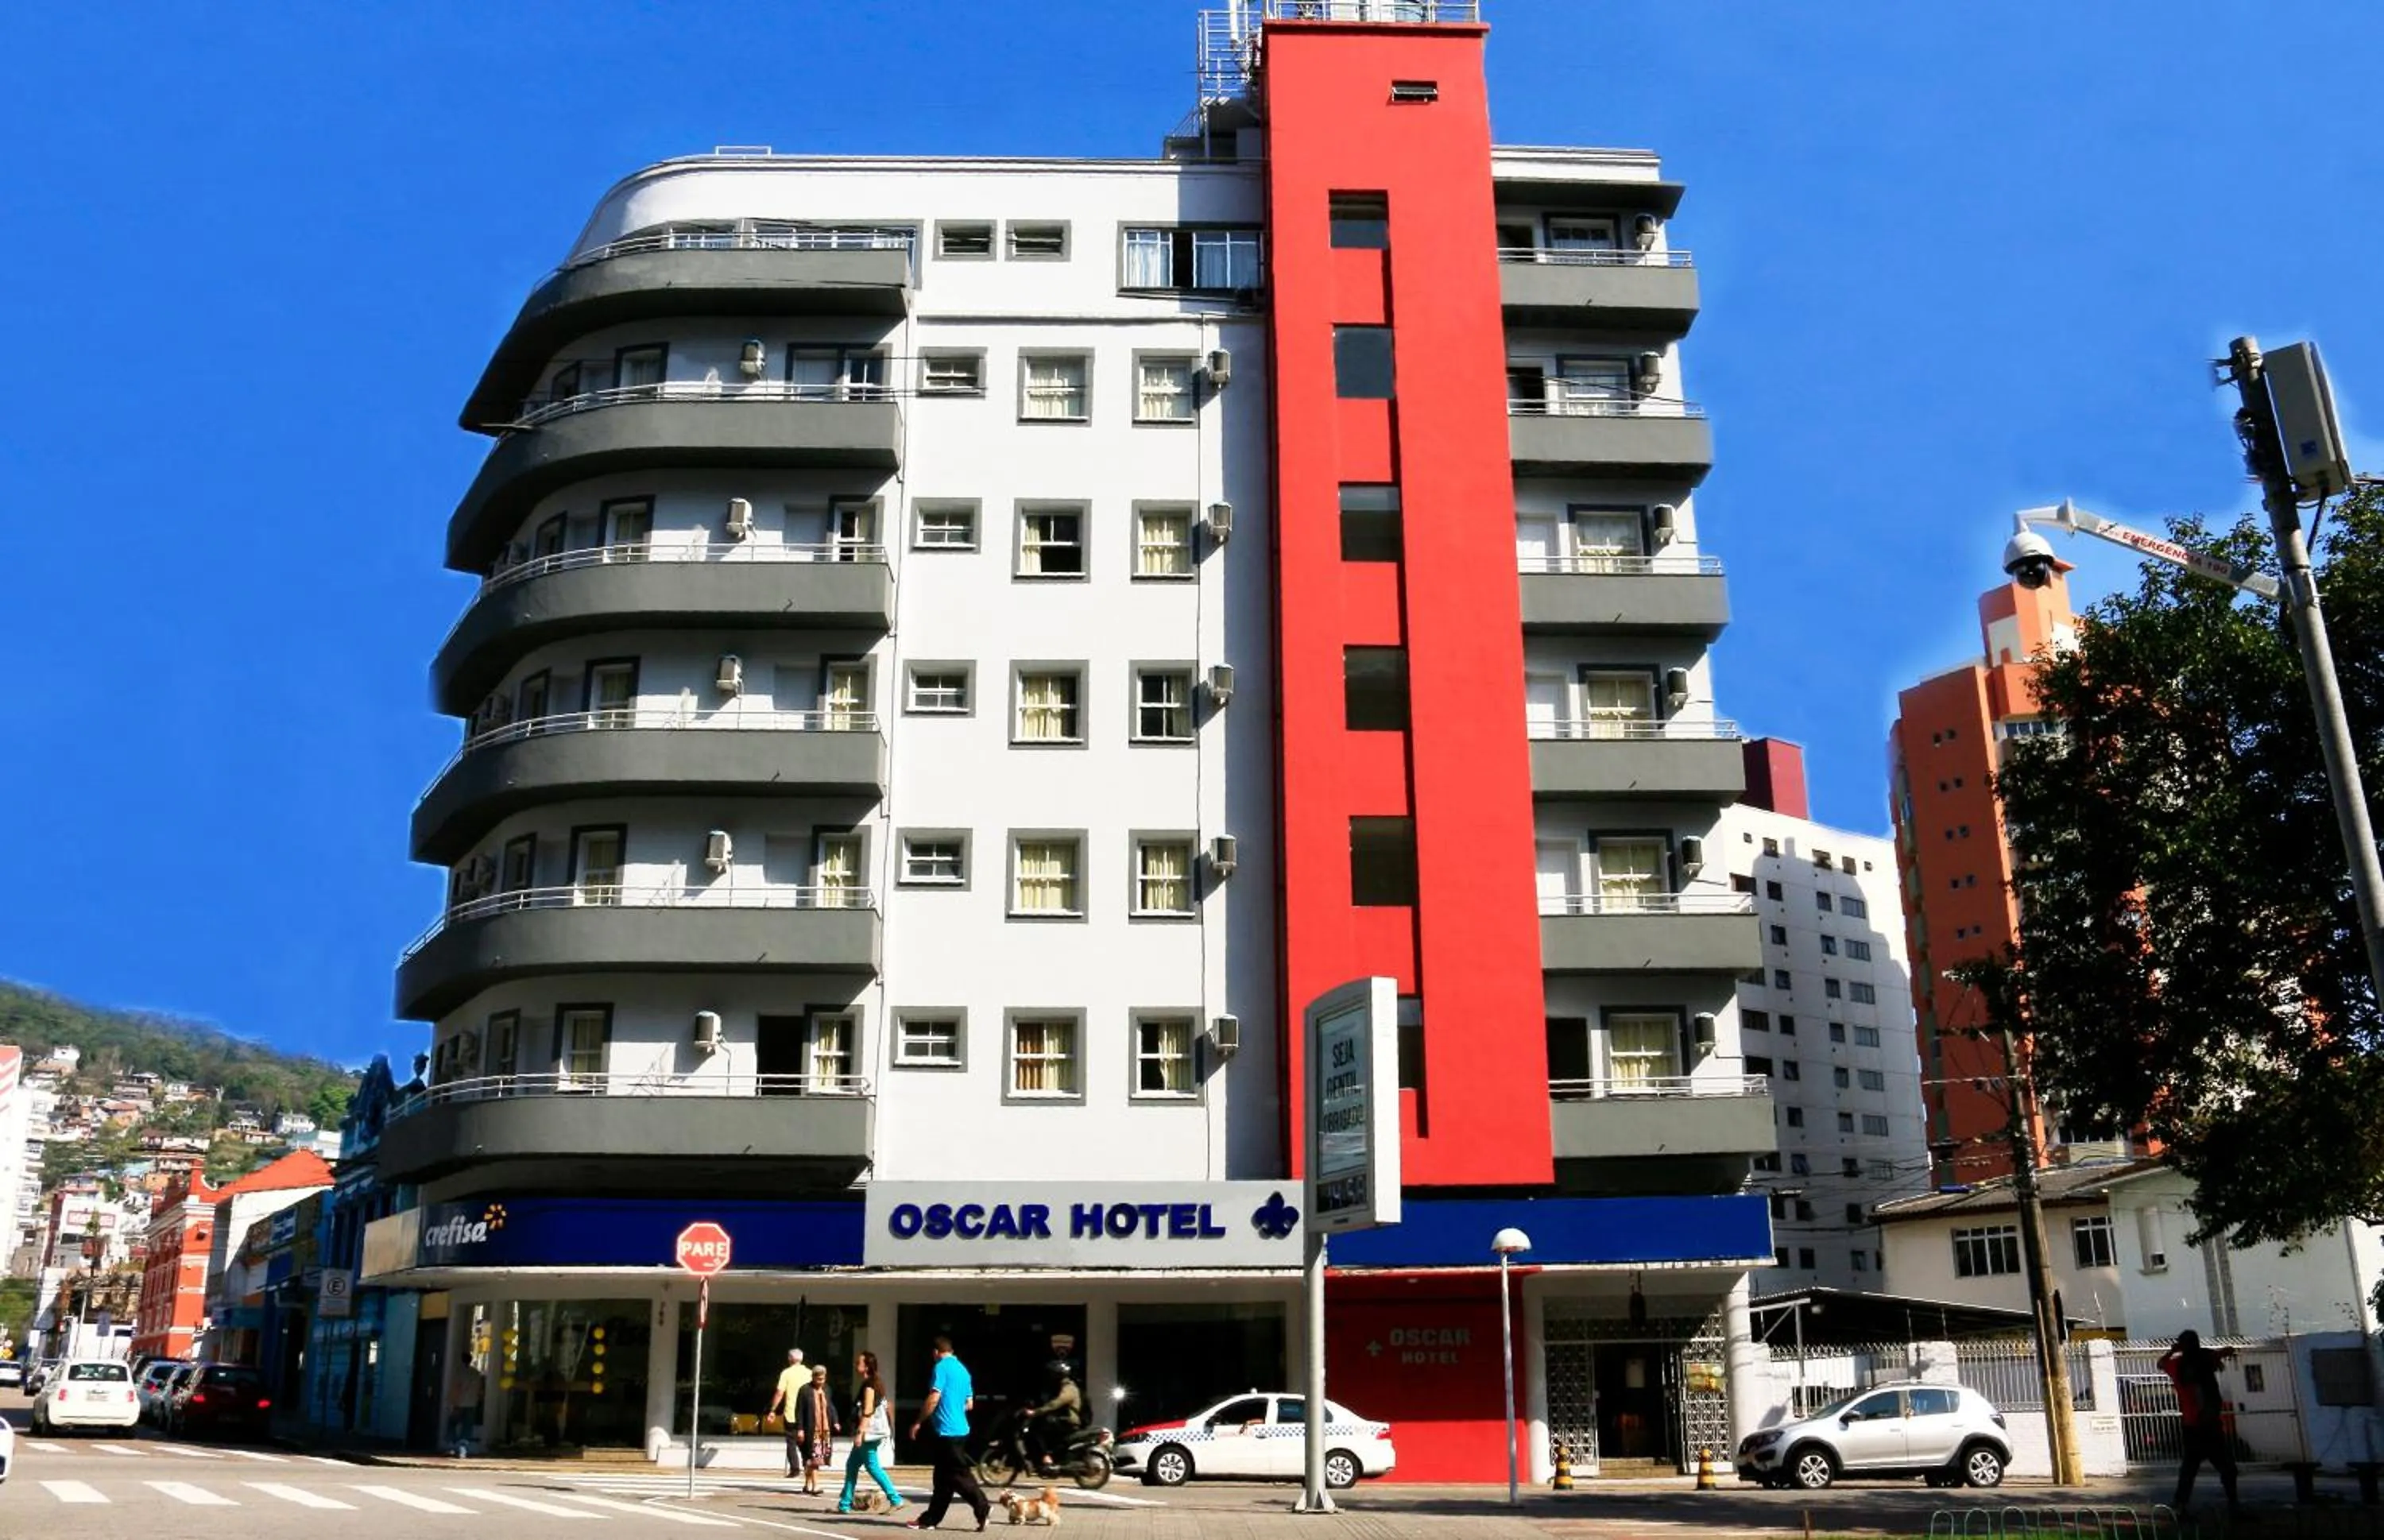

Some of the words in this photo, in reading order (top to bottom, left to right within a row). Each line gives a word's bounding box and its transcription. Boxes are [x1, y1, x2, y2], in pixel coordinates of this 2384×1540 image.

[1333, 1037, 1355, 1069] SEJA
[425, 1214, 487, 1247] crefisa
[888, 1204, 1051, 1240] OSCAR
[1070, 1204, 1226, 1240] HOTEL
[682, 1241, 727, 1257] PARE
[1389, 1328, 1471, 1347] OSCAR
[1401, 1351, 1459, 1364] HOTEL
